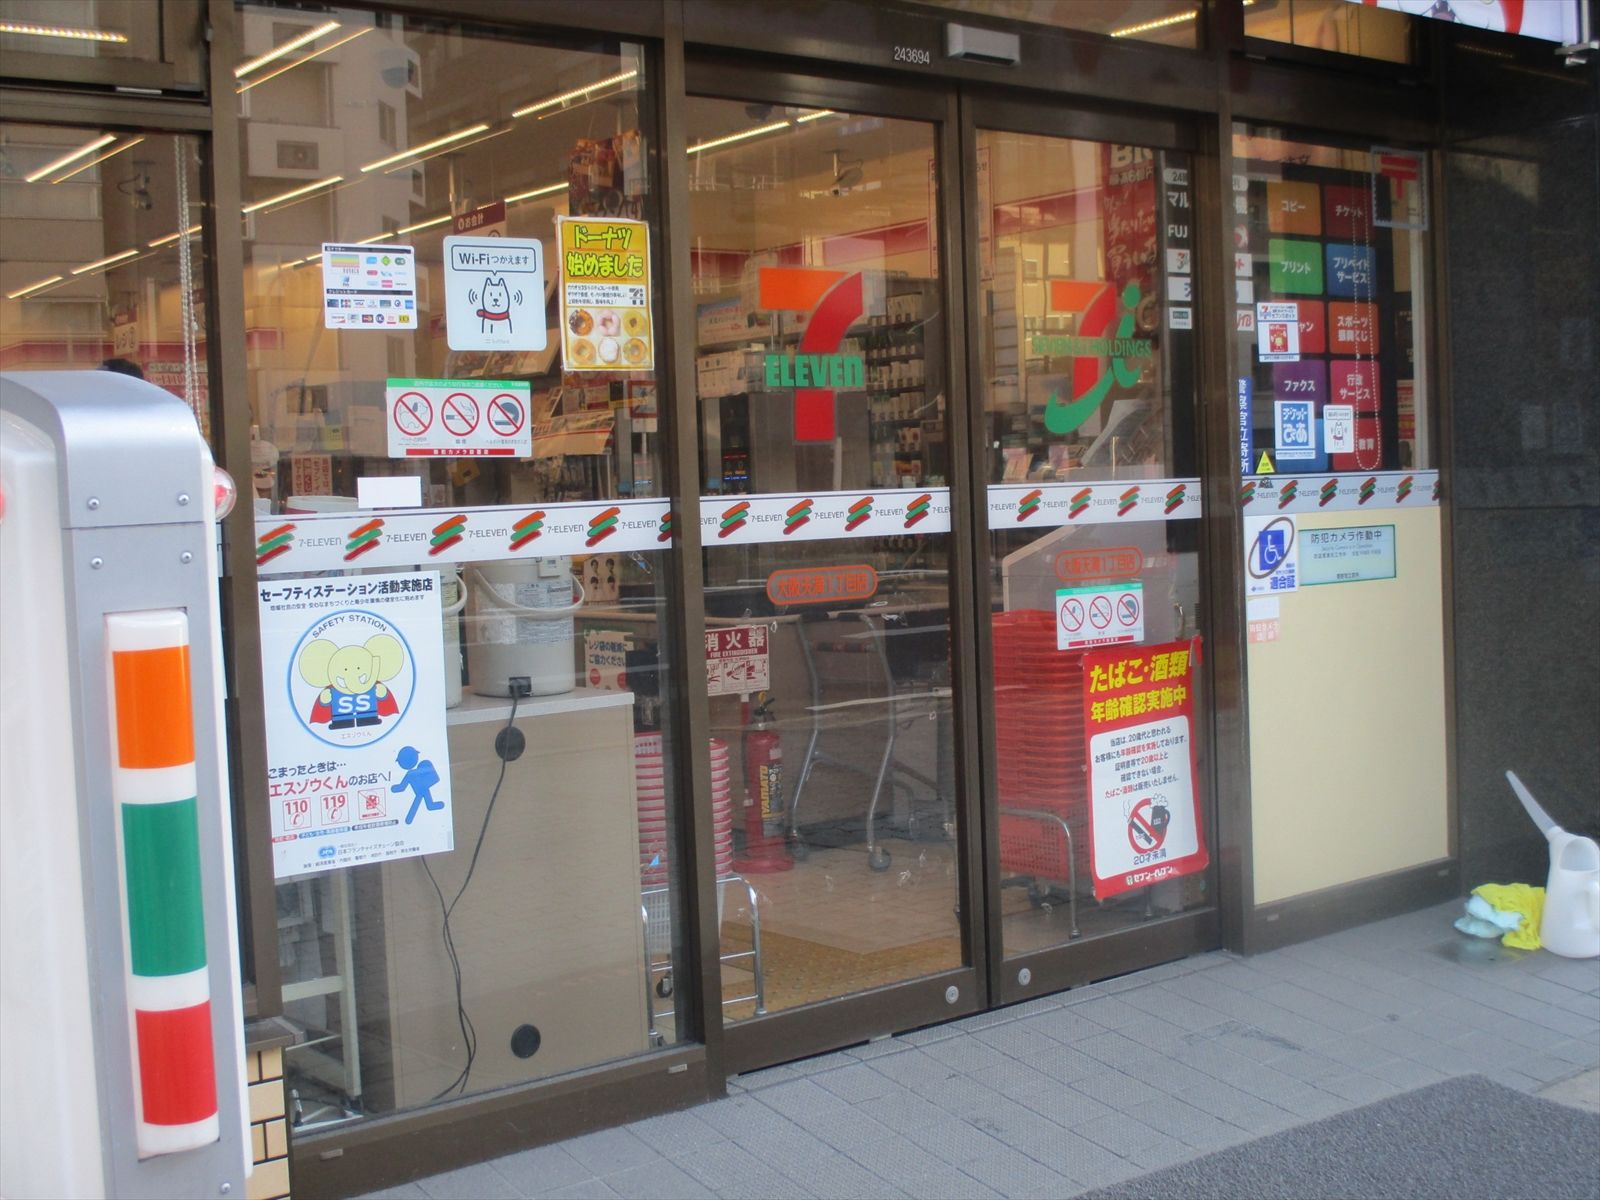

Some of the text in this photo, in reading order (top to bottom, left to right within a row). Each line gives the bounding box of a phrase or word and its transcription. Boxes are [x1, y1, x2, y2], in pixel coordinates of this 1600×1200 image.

[894, 46, 930, 64] 243694
[1167, 192, 1189, 208] マル
[1281, 200, 1306, 212] コピー
[1335, 205, 1363, 218] チケット
[574, 224, 633, 250] ドーナツ
[1168, 224, 1188, 238] FUJ
[458, 253, 529, 265] Wi-Fi つかえます
[566, 251, 644, 278] 始めました
[1280, 260, 1311, 274] プリント
[1333, 257, 1369, 270] プリペイド
[1336, 271, 1367, 284] サービス
[1337, 315, 1369, 327] スポーツ
[1284, 379, 1316, 392] ファクス
[1339, 388, 1370, 400] サービス
[1283, 422, 1308, 444] ぴあ
[1311, 530, 1382, 544] 防犯カメラ作動中
[260, 578, 433, 602] セーフティステーション活動実施店
[312, 614, 387, 638] SAFETY STATION
[705, 628, 765, 652] 消火器
[1089, 650, 1189, 694] たばこ・酒類
[338, 694, 371, 713] SS
[1091, 684, 1186, 723] 年齢確認実施中
[285, 794, 346, 815] 110 119
